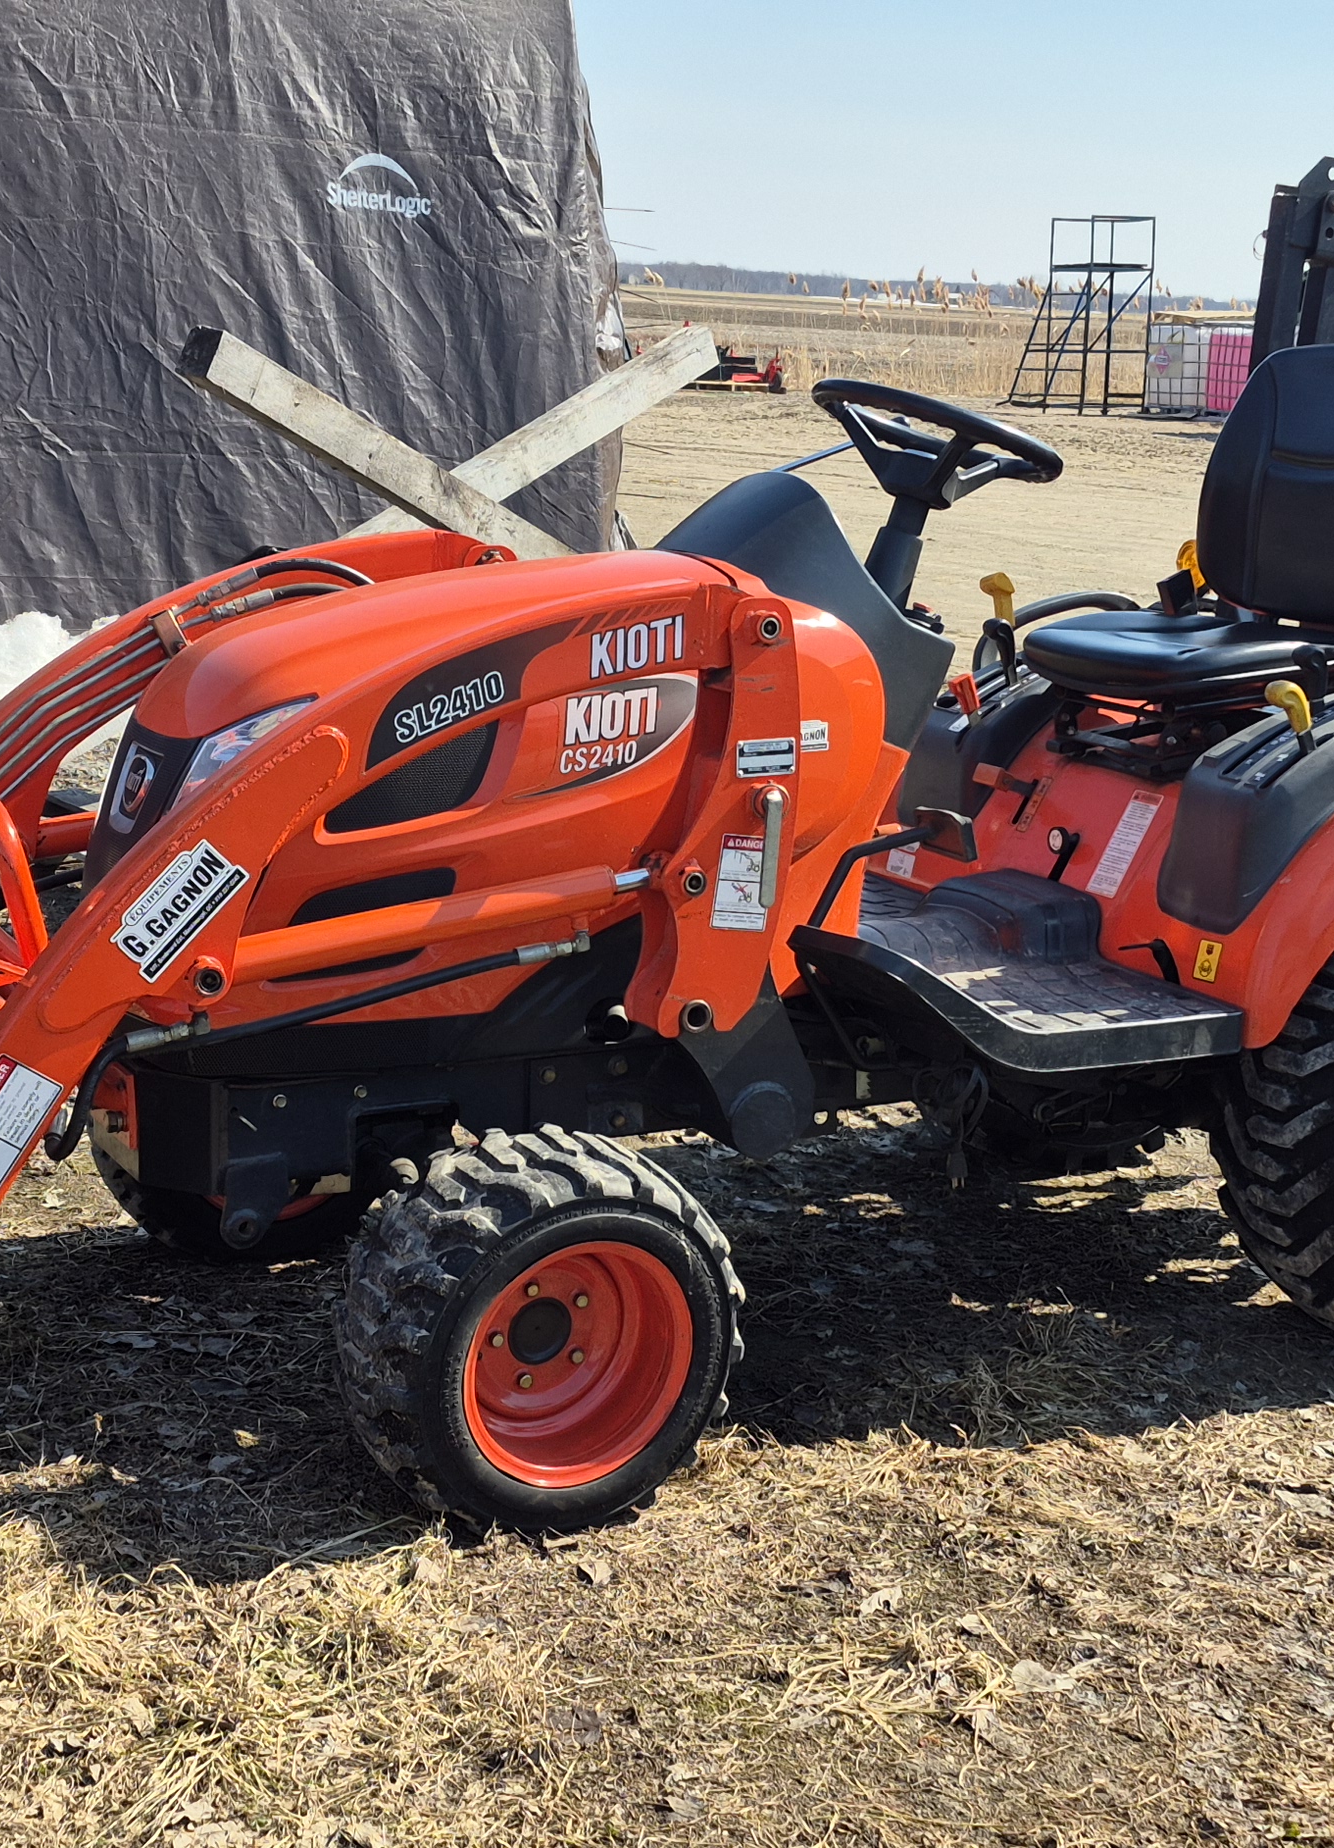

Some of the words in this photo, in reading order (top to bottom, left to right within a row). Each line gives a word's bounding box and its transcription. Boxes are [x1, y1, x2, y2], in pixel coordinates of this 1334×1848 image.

[326, 181, 432, 218] ShelterLogic
[589, 612, 685, 680] KIOTI
[393, 671, 506, 744] SL2410
[563, 684, 659, 747] KIOTI
[559, 739, 638, 775] CS2410
[800, 727, 826, 742] GNON
